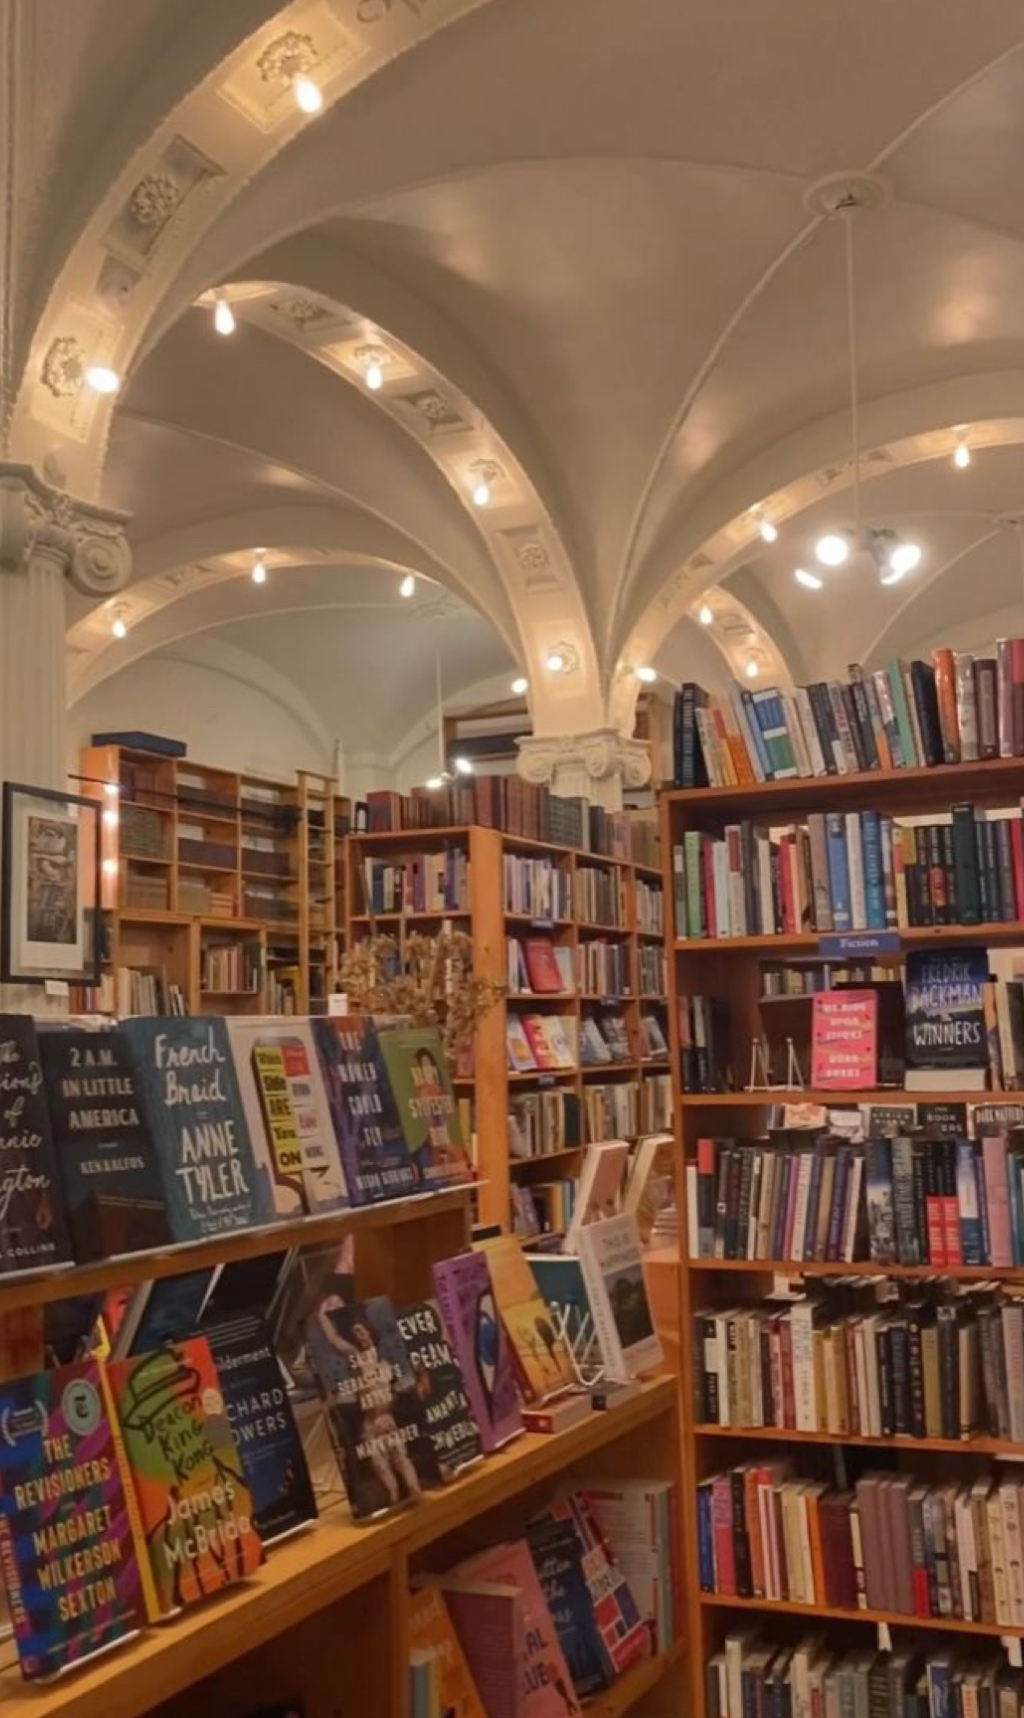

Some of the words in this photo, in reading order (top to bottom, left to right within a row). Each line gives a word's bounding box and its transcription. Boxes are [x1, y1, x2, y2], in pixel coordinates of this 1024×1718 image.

[840, 937, 879, 949] Fiction
[921, 962, 972, 984] FREDRIK
[910, 983, 982, 1011] BACKMAN
[154, 1026, 226, 1069] French
[913, 1020, 981, 1046] WINNERS
[70, 1047, 82, 1067] 2
[62, 1079, 81, 1097] IN
[82, 1077, 134, 1096] LITTLE
[165, 1068, 227, 1105] Braid
[4, 1096, 25, 1128] of
[69, 1108, 140, 1129] AMERICA
[939, 1124, 964, 1133] ERS
[180, 1119, 239, 1163] ANNE
[80, 1160, 104, 1175] KEN
[104, 1156, 145, 1173] KALFUS
[280, 1151, 303, 1167] ON
[0, 1164, 51, 1222] gton
[175, 1160, 250, 1204] TYLER
[396, 1310, 438, 1341] EVER
[217, 1347, 271, 1369] ilderment
[226, 1388, 284, 1421] CHARD
[425, 1390, 468, 1424] AMANTA
[158, 1421, 204, 1462] King
[230, 1411, 288, 1446] OWERS
[43, 1434, 73, 1463] THE
[171, 1438, 215, 1484] Kong
[14, 1457, 111, 1511] REVISIONERS
[167, 1481, 235, 1525] James
[32, 1505, 111, 1556] MARGARET
[163, 1511, 251, 1571] McBride
[37, 1538, 122, 1591] WILKERSON
[58, 1576, 117, 1621] SEXTON
